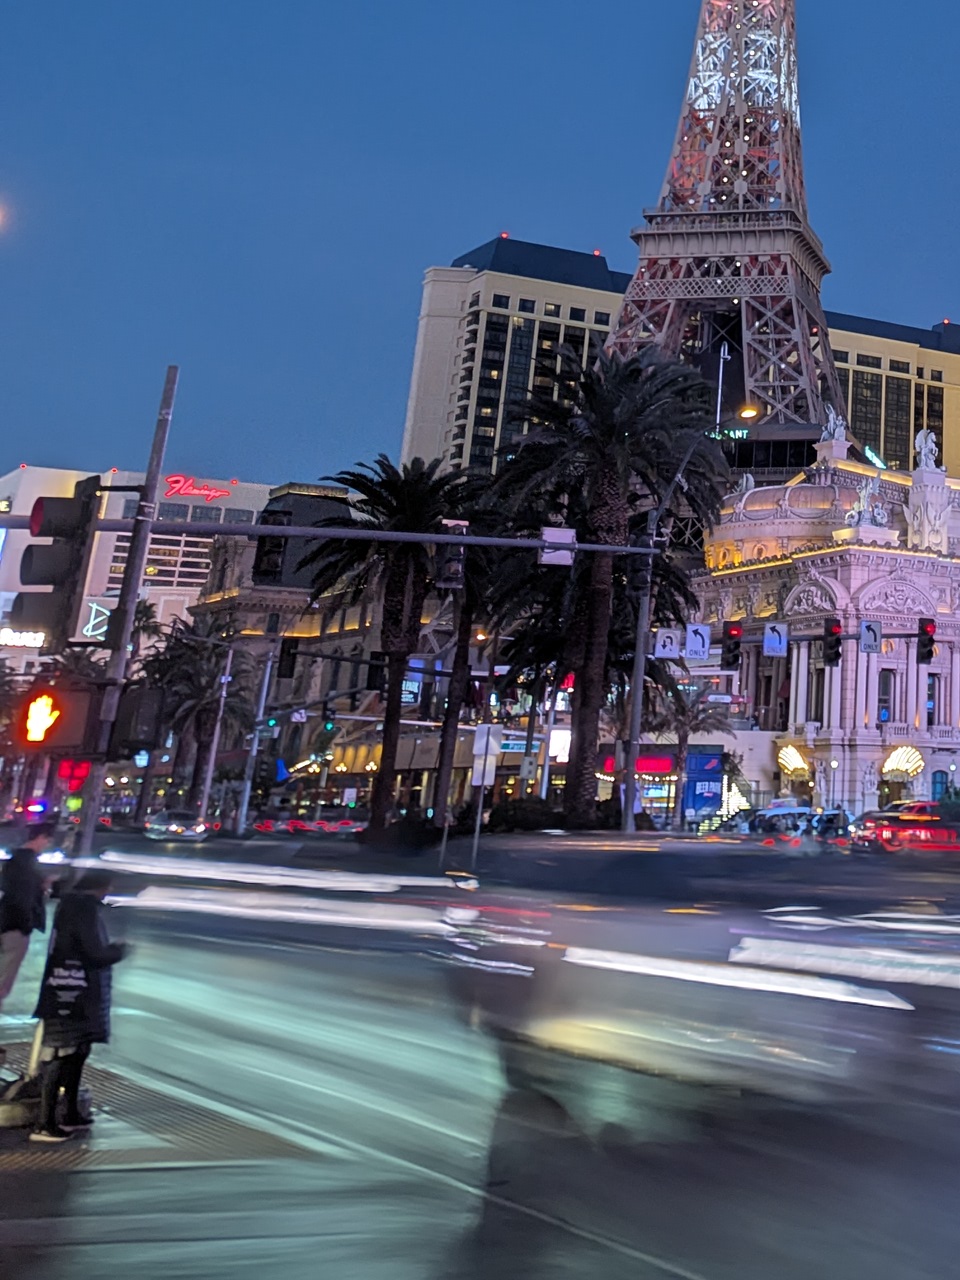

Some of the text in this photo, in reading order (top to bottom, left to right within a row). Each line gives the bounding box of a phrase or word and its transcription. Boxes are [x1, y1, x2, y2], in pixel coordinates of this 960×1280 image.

[165, 475, 230, 501] Flamingo
[766, 646, 783, 655] ONLY
[862, 643, 878, 652] ONLY
[689, 649, 706, 658] ONLY
